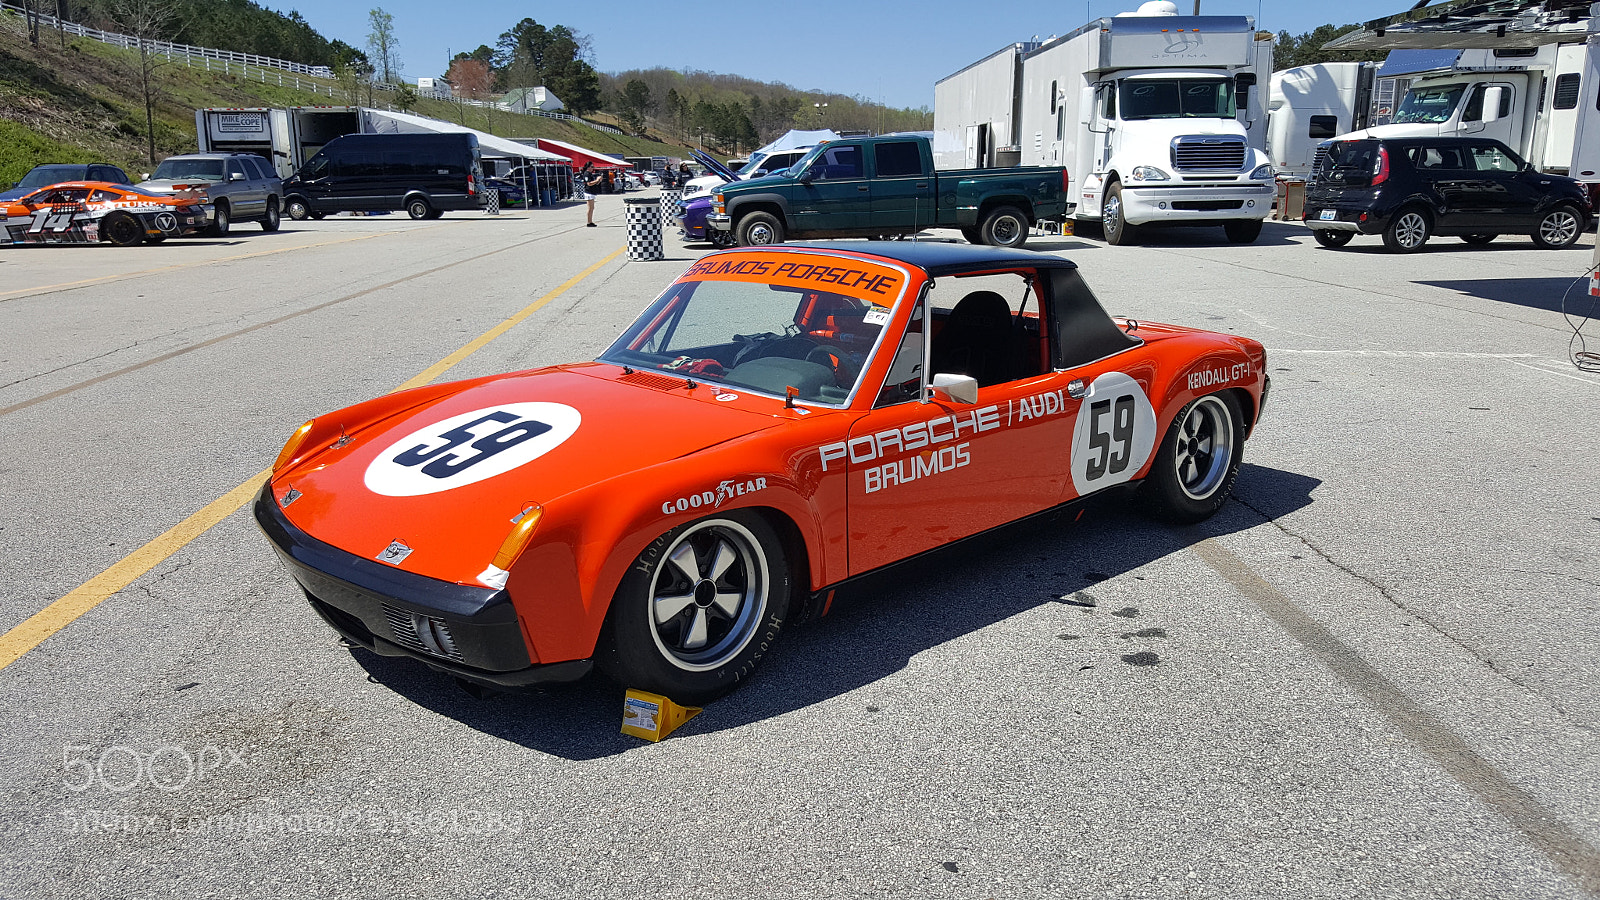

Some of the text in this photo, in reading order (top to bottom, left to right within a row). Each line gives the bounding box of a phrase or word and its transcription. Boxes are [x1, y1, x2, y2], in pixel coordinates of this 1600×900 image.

[221, 115, 240, 123] MIKE
[240, 118, 260, 126] COPE
[28, 206, 72, 234] 14
[684, 260, 898, 295] BRUMOS PORSCHE
[1187, 366, 1229, 390] KENDALL
[392, 410, 554, 479] 59
[818, 404, 1001, 472] PORSCHE
[1085, 394, 1135, 482] 59
[864, 442, 971, 494] BRUMOS
